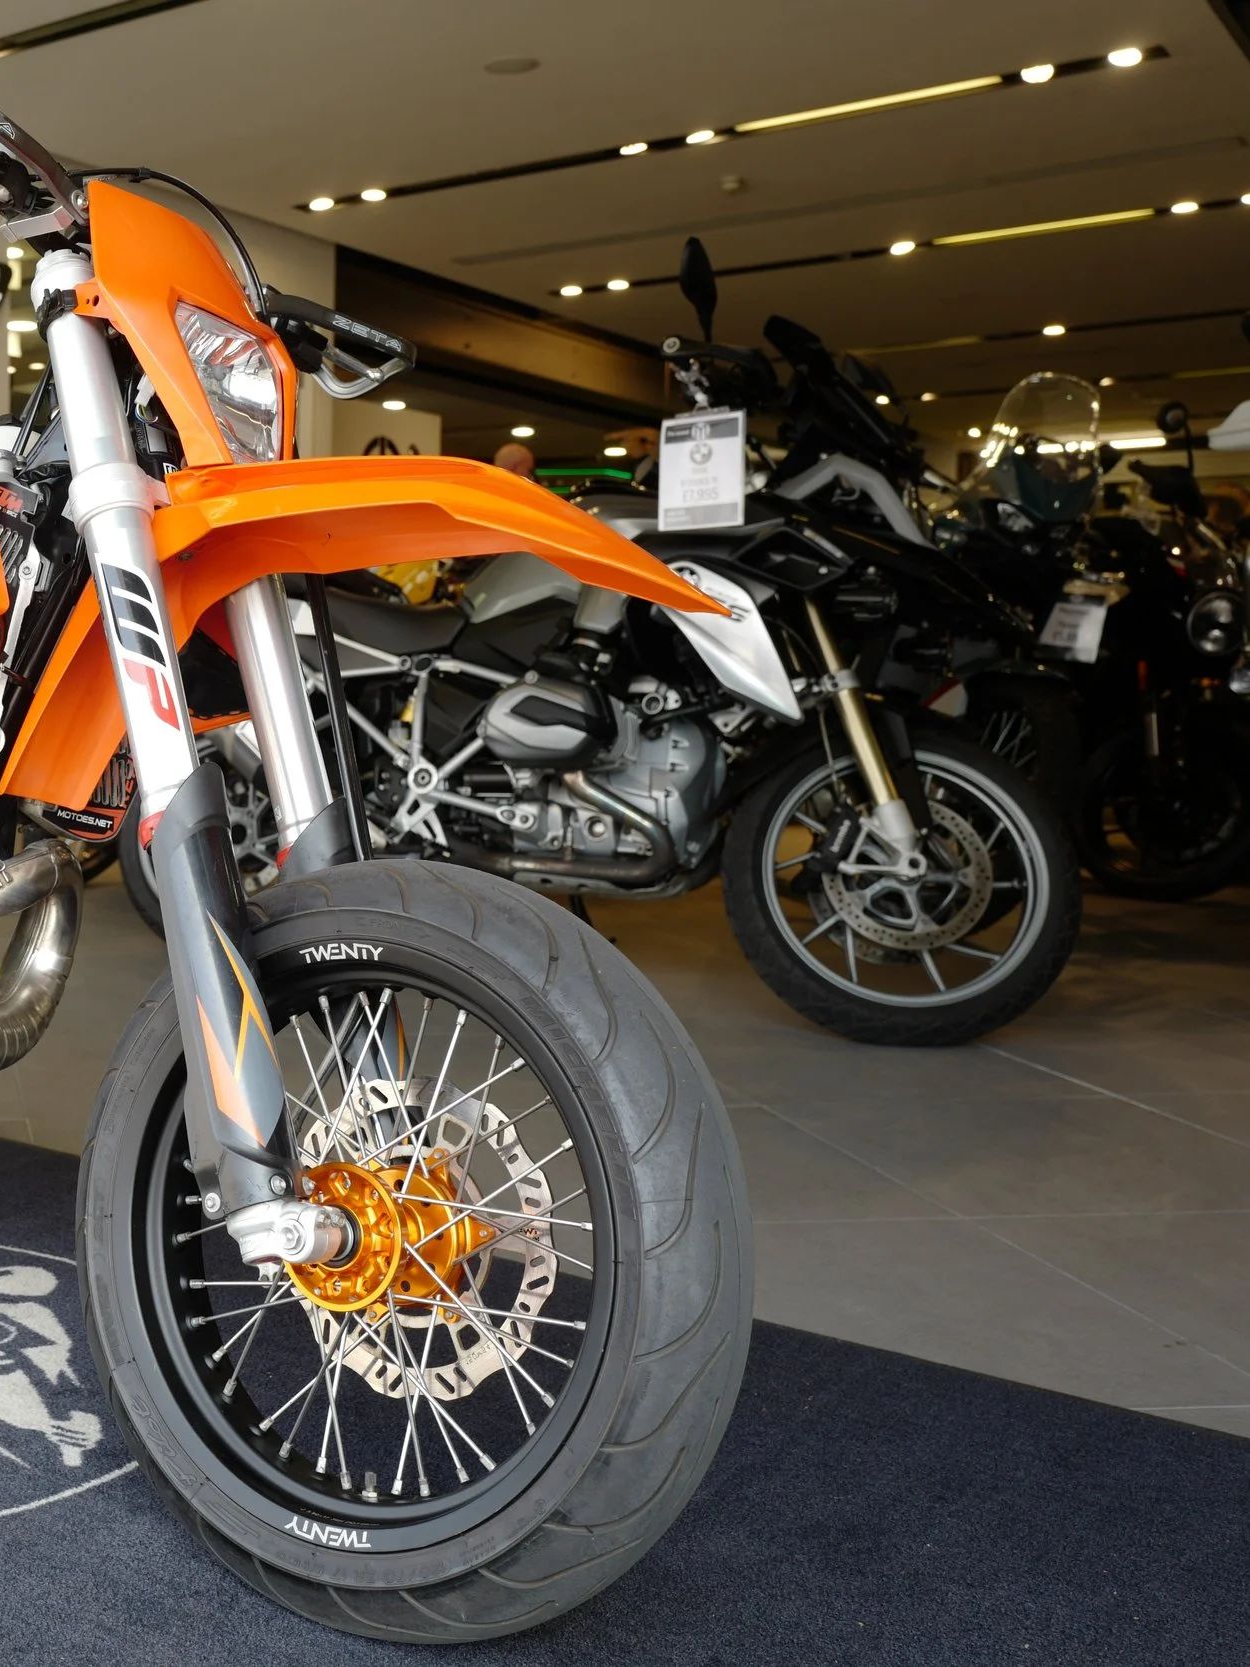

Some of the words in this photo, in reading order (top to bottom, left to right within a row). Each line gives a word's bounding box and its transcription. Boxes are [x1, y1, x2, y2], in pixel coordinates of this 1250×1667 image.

[332, 314, 402, 352] ZETA
[56, 808, 114, 829] MOTOES.NET
[299, 942, 384, 964] TWENTY
[284, 1515, 372, 1548] TWENTY
